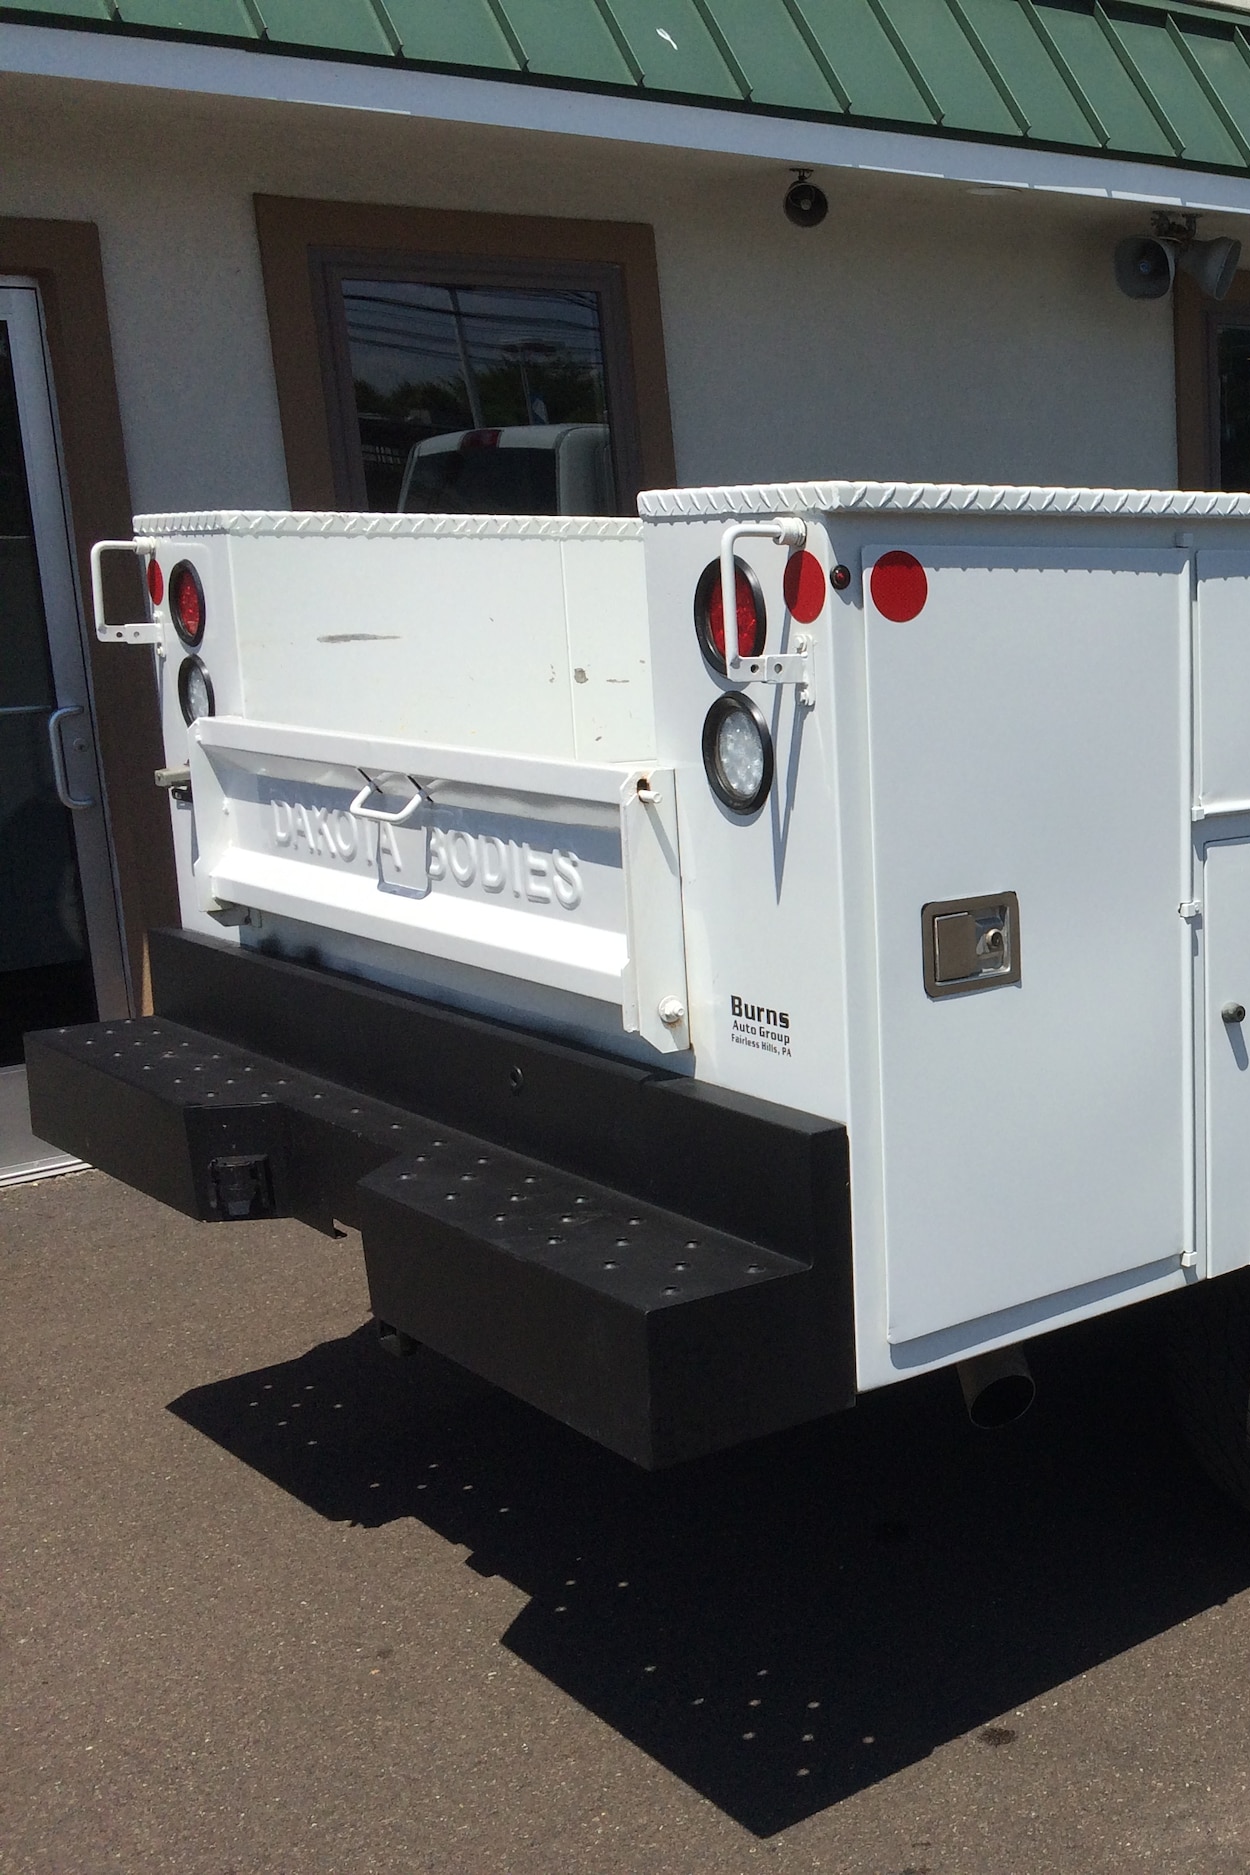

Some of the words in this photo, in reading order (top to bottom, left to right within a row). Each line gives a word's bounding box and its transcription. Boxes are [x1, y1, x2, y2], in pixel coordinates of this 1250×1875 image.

[271, 799, 402, 873] DAKOTA
[421, 825, 584, 911] BODIES
[730, 994, 790, 1029] Burns
[731, 1033, 760, 1049] Fairless
[761, 1040, 781, 1056] Hills,
[781, 1046, 792, 1058] PA
[732, 1019, 757, 1036] Auto
[759, 1026, 791, 1046] Group
